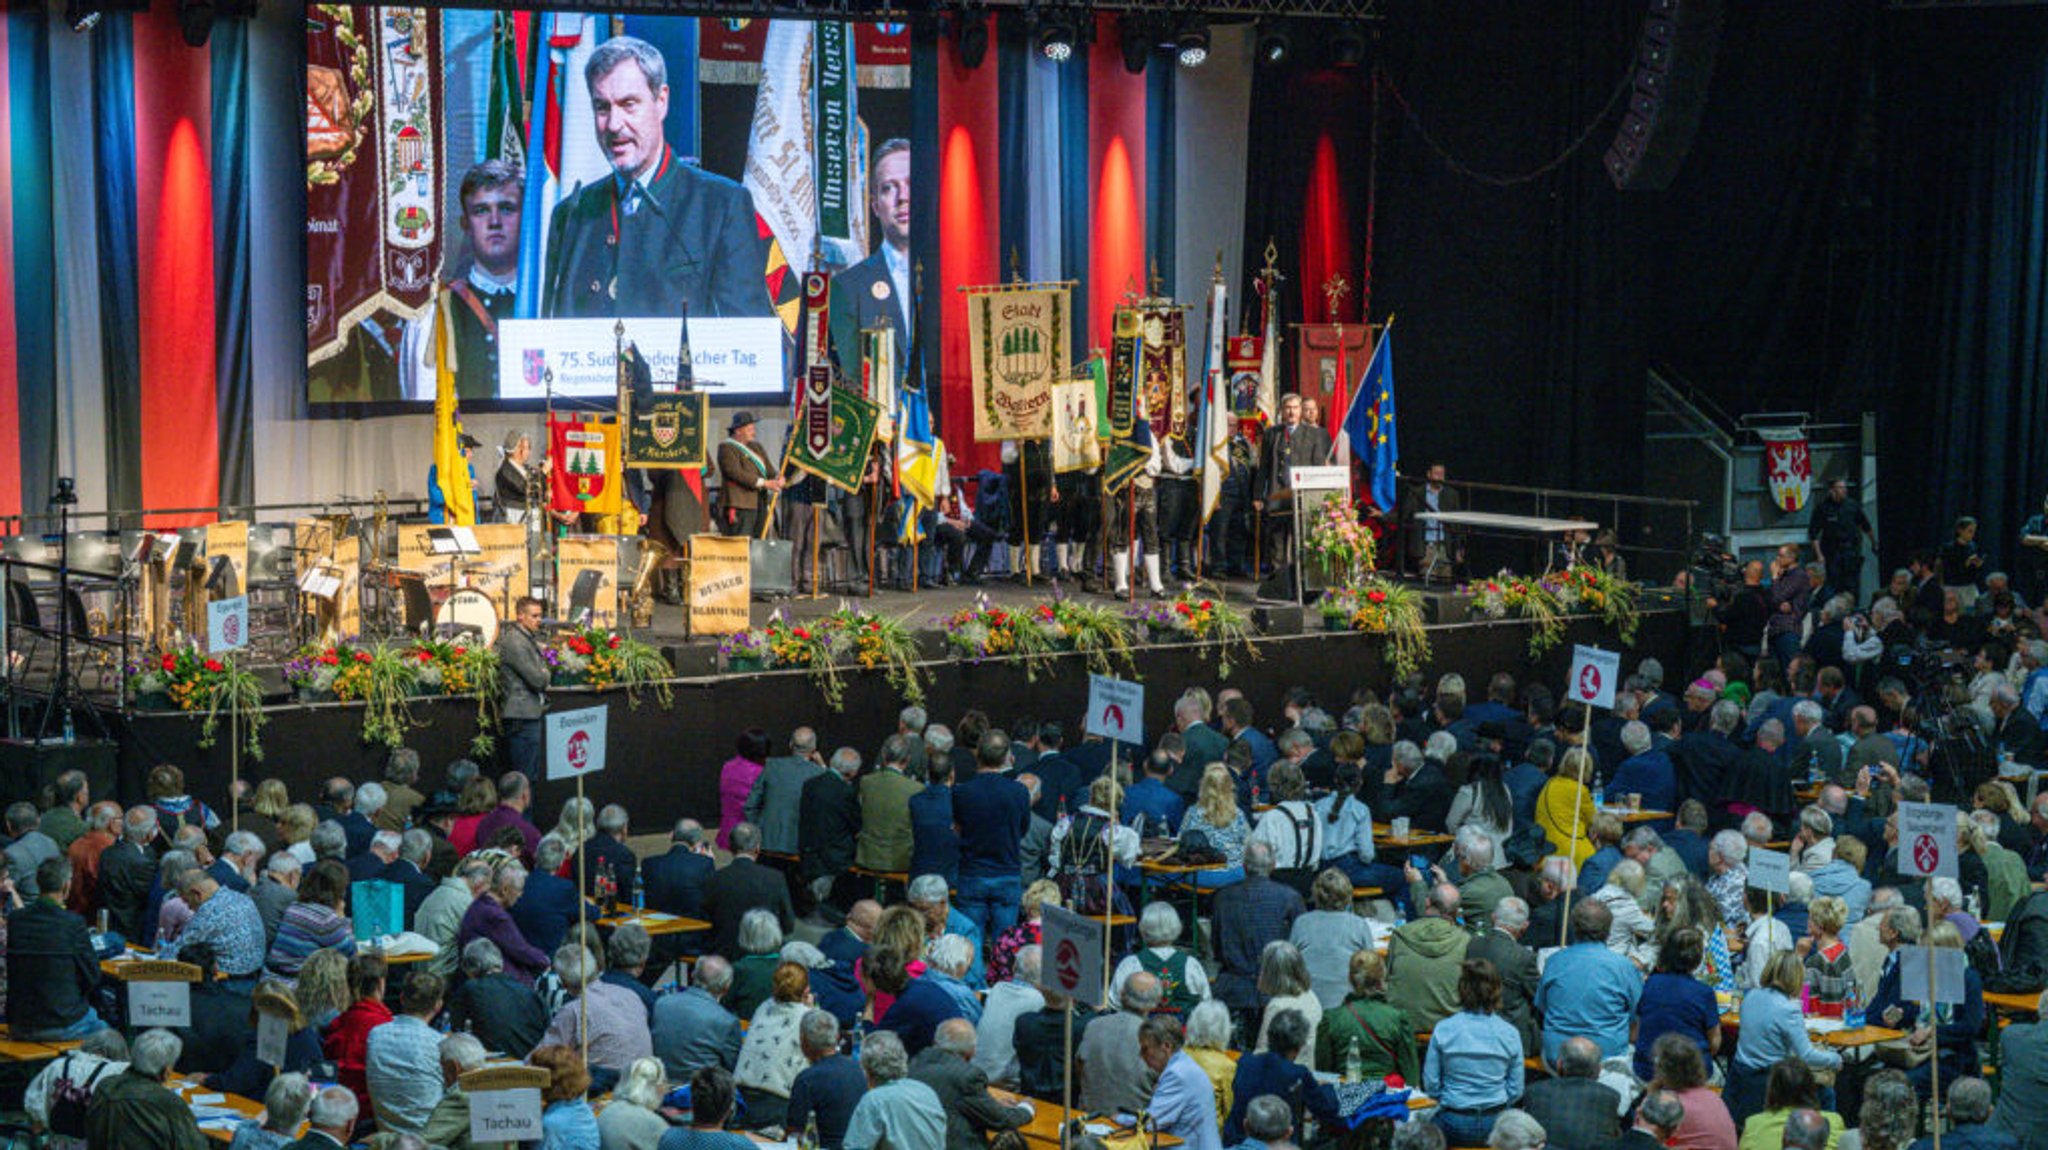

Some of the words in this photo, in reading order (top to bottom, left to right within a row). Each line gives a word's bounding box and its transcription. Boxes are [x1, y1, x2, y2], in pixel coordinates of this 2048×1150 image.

[560, 350, 583, 368] 75.
[731, 348, 757, 367] Tag
[482, 1115, 532, 1131] Tachau
